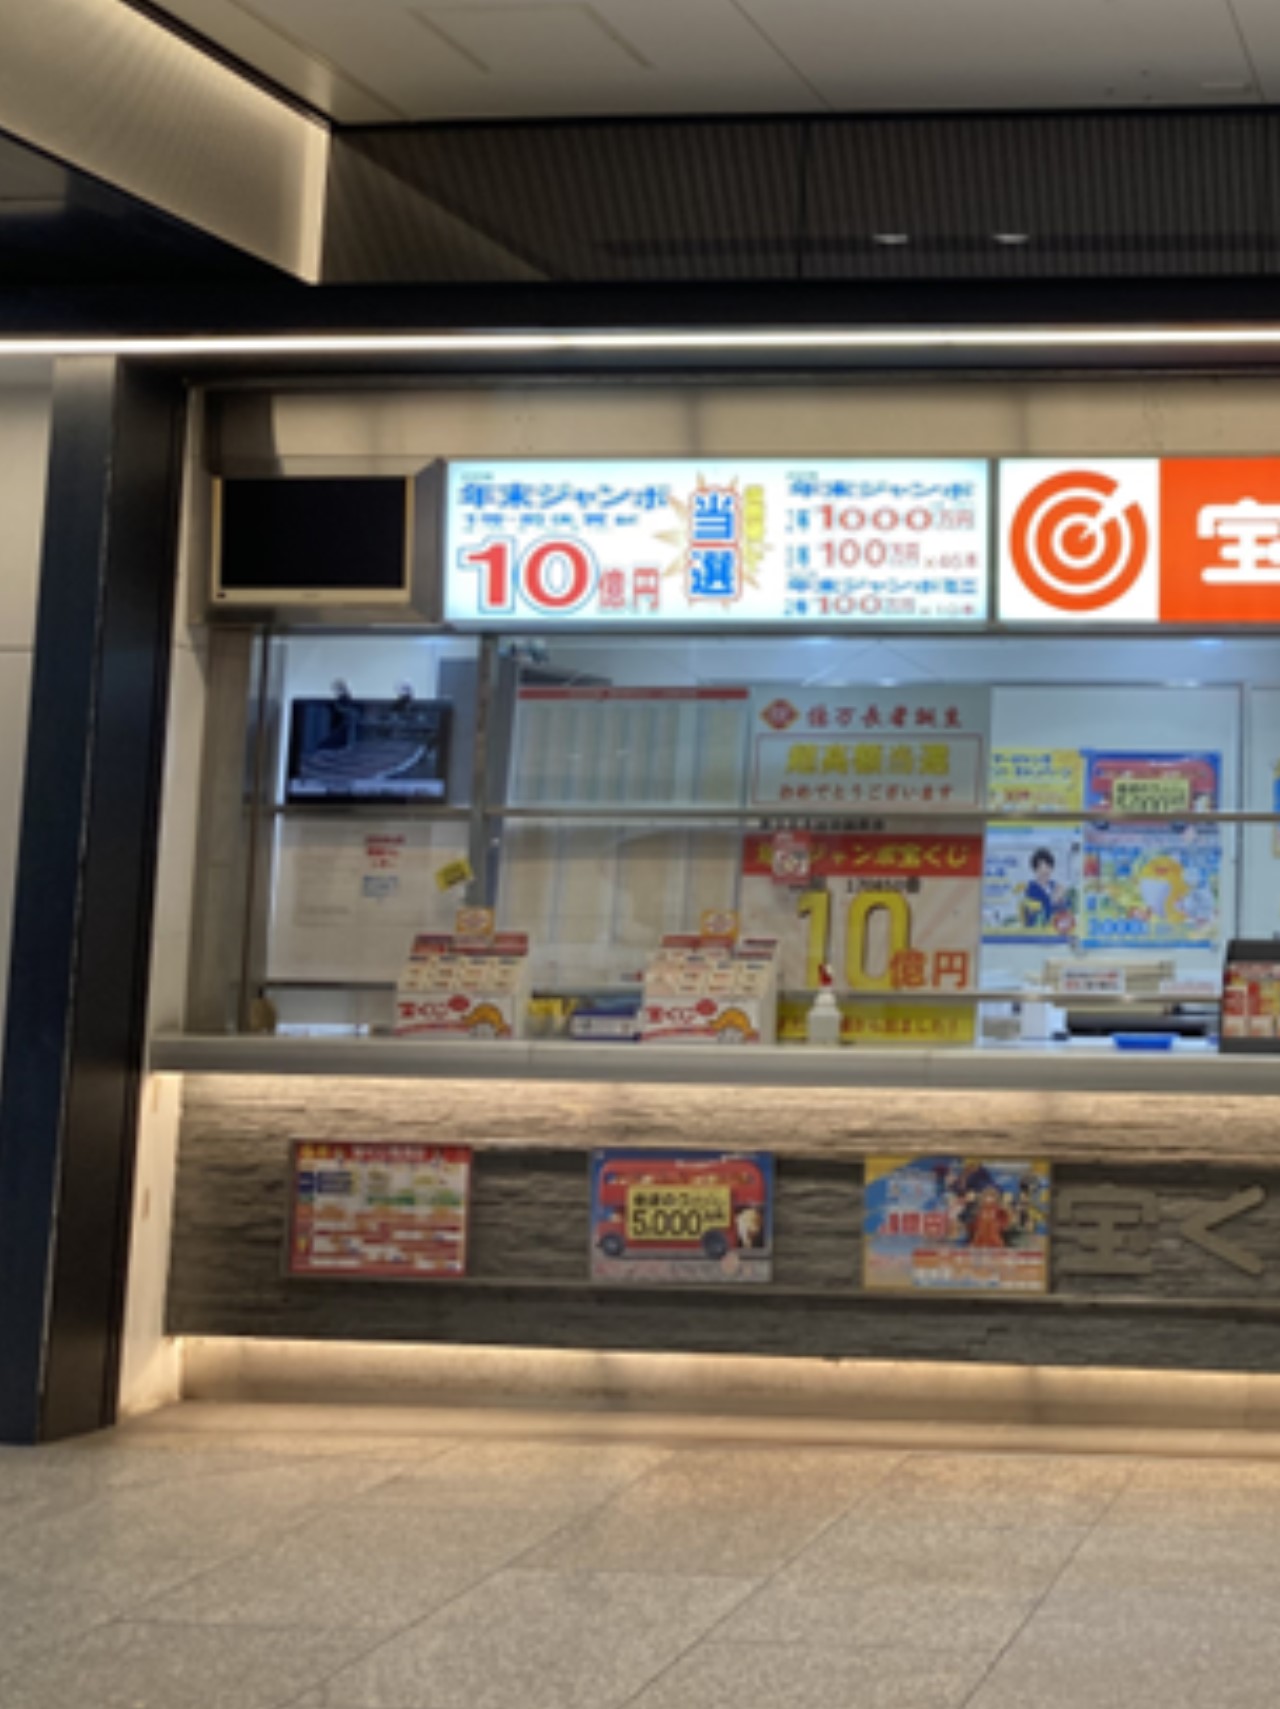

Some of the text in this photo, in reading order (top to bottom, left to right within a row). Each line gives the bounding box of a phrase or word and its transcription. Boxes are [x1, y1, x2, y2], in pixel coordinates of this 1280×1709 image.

[458, 482, 671, 511] 年末ジャンボ
[457, 535, 661, 614] 10億円
[691, 491, 735, 598] 当選
[796, 889, 970, 990] 10億円
